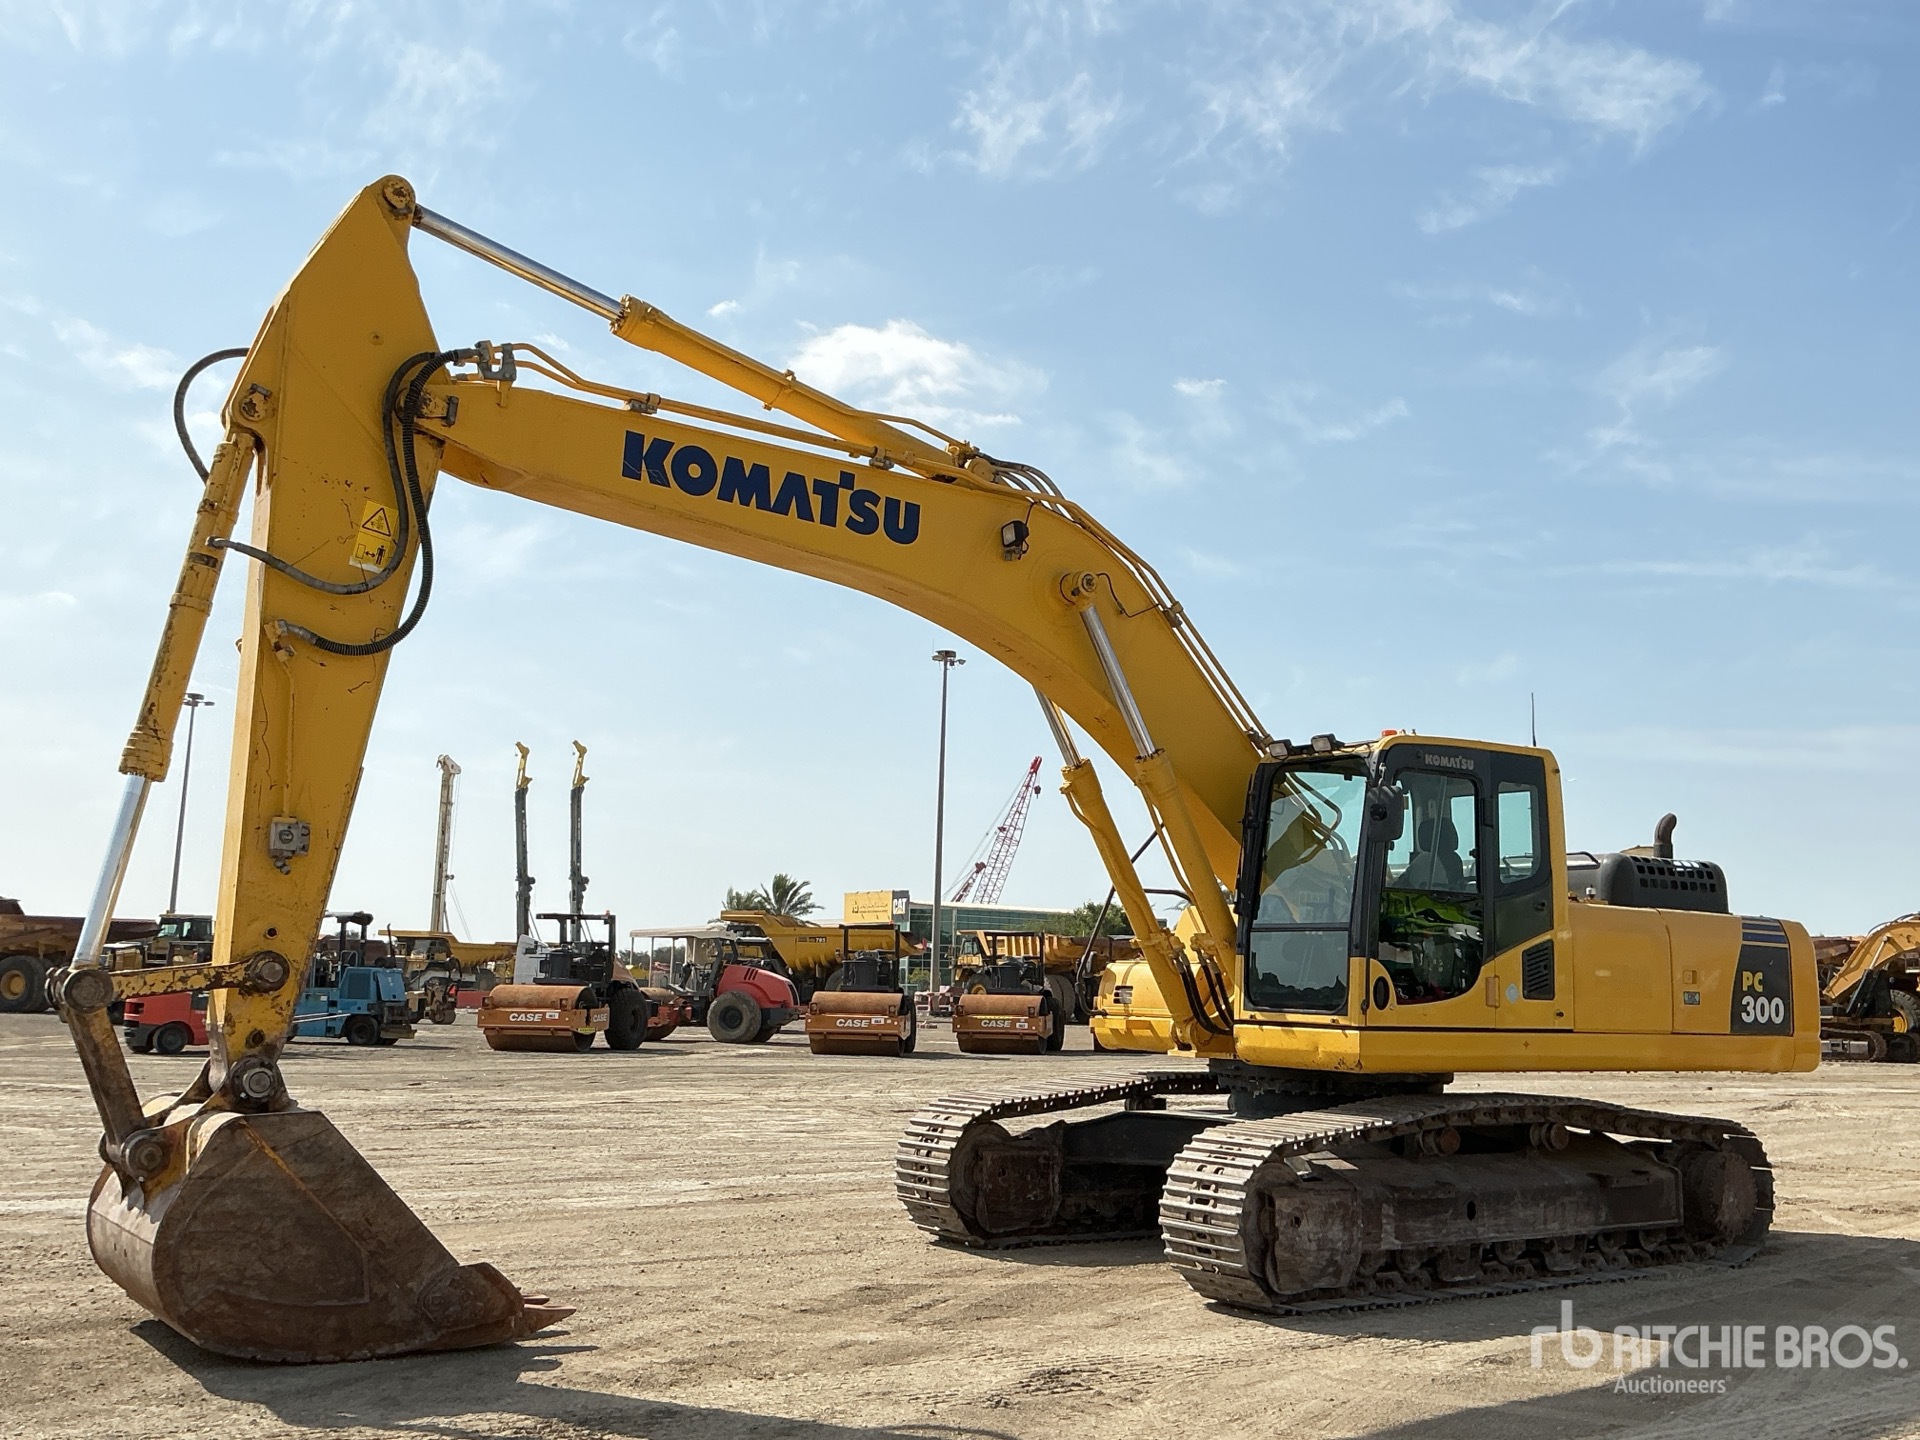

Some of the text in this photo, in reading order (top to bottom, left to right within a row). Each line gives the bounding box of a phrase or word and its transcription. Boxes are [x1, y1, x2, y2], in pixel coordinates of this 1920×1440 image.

[621, 430, 921, 545] KOMATSU
[1424, 753, 1474, 770] KOMATSU
[893, 897, 908, 915] CAT
[1742, 971, 1763, 992] PC
[509, 1013, 543, 1022] CASE
[592, 1013, 607, 1023] CASE
[1741, 995, 1785, 1024] 300
[836, 1018, 870, 1028] CASE
[981, 1019, 1012, 1028] CASE
